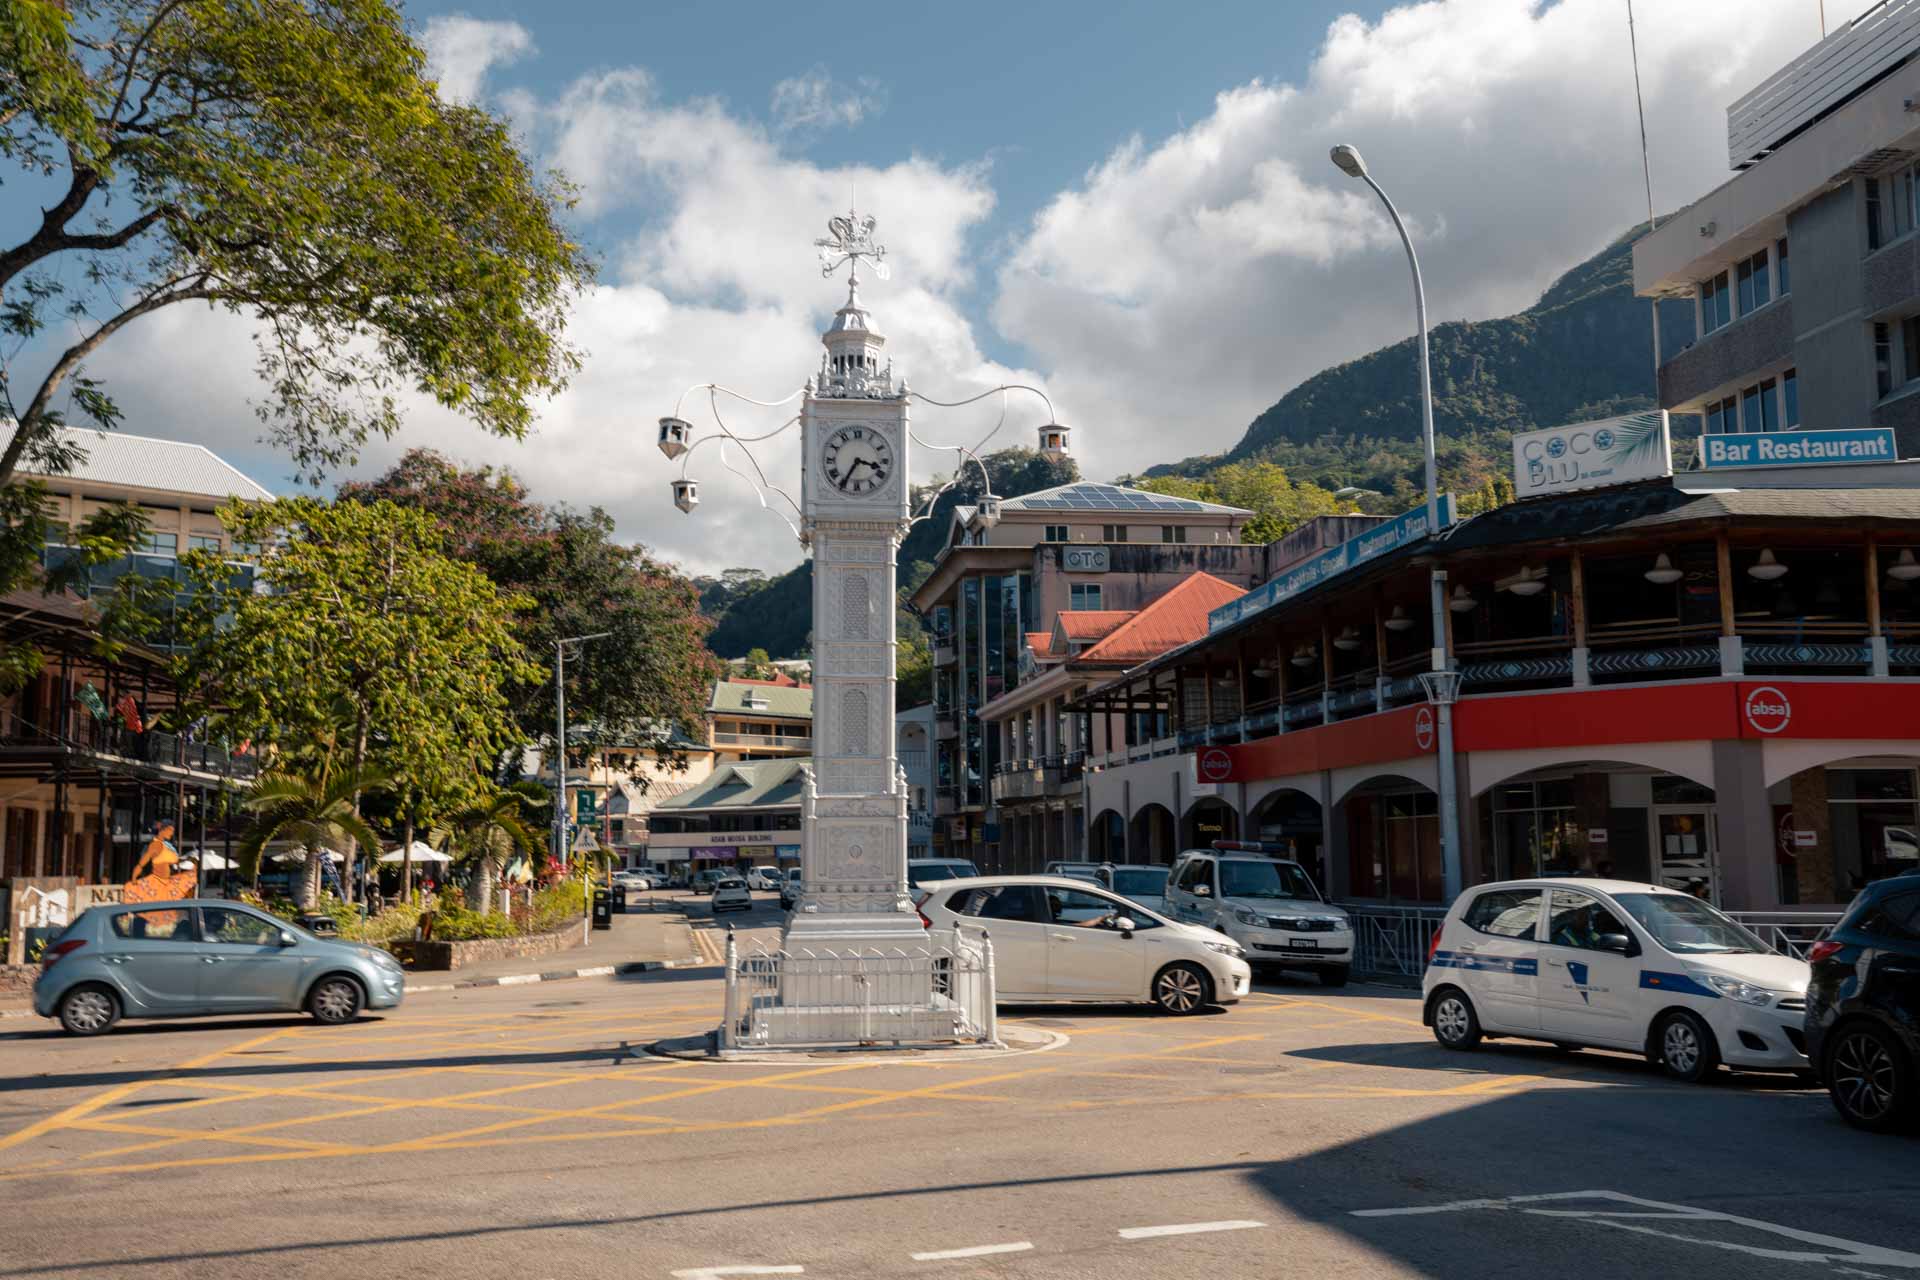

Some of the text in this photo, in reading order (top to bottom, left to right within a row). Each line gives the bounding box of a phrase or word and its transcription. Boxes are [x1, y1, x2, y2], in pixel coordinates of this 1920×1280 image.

[1523, 429, 1615, 461] COCO
[1711, 435, 1888, 461] Bar Restaurant
[1069, 551, 1104, 567] OTC
[1752, 701, 1785, 716] absa
